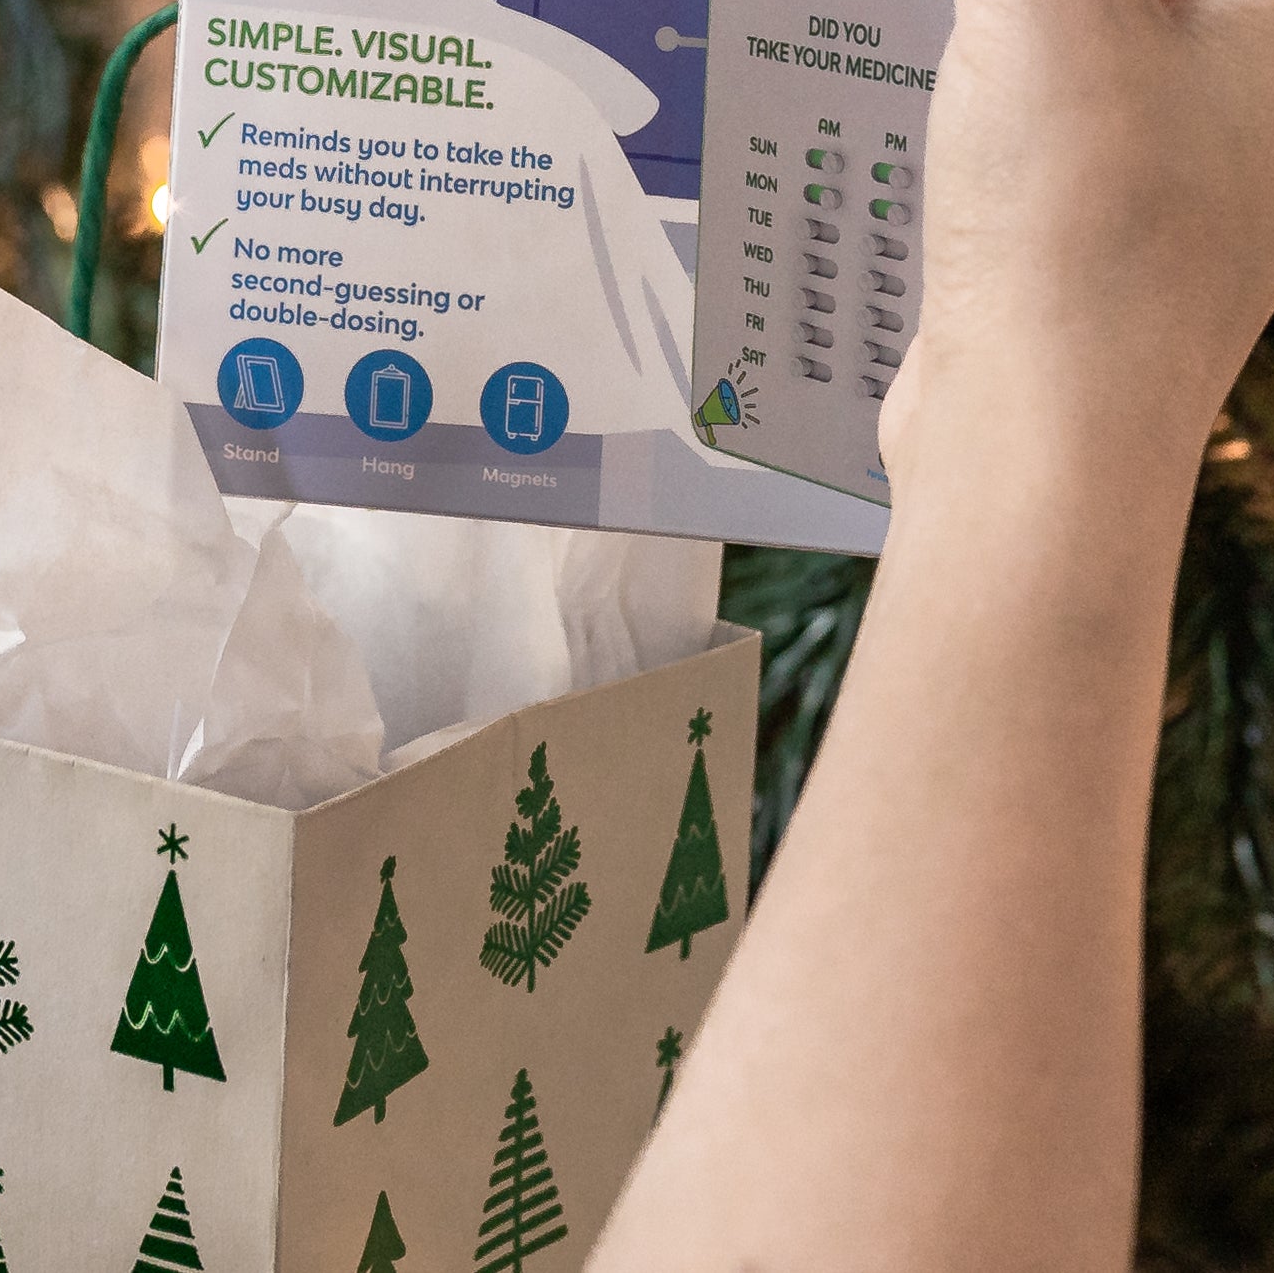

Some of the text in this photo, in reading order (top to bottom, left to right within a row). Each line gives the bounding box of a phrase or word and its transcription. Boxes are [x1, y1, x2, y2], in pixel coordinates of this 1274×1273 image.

[207, 17, 492, 69] SIMPLE. VISUAL.
[808, 15, 881, 48] DID YOU
[746, 35, 937, 92] TAKE YOUR MEDICINE
[204, 57, 494, 110] CUSTOMIZABLE.
[817, 117, 841, 138] AM
[241, 122, 553, 171] Reminds you to take the
[749, 136, 778, 158] SUN
[884, 132, 907, 152] PM
[238, 156, 576, 209] meds without interrupting
[745, 171, 778, 194] MON
[236, 189, 426, 227] your busy day.
[747, 207, 773, 228] TUE
[233, 236, 343, 267] No more
[743, 241, 774, 264] WED
[231, 272, 486, 314] second-guessing or
[743, 276, 770, 298] THU
[229, 299, 425, 342] double-dosing.
[745, 312, 765, 332] FRI
[741, 346, 767, 367] SAT
[222, 442, 280, 464] Stand
[361, 455, 416, 480] Hang
[482, 466, 558, 489] Magnets
